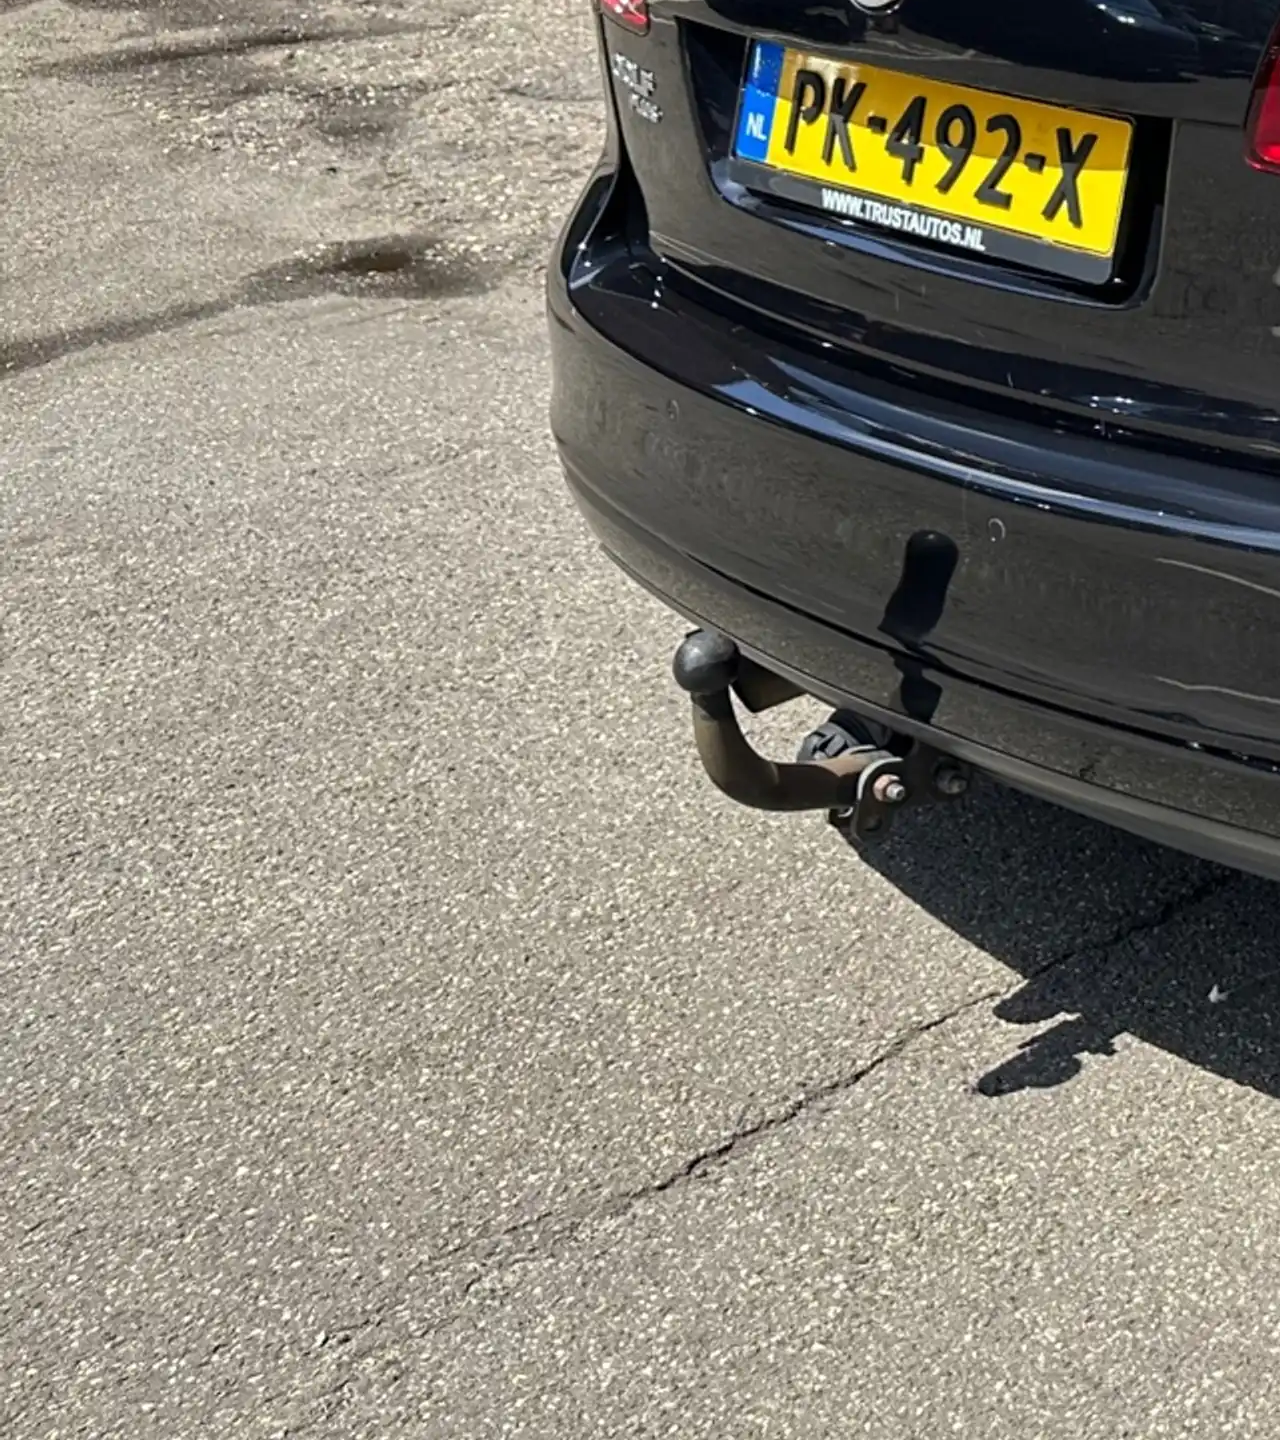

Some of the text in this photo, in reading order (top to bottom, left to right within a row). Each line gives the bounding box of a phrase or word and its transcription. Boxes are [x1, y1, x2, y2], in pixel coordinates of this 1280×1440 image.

[745, 68, 1099, 229] NL PK-492-X
[821, 187, 987, 252] WWW.TRUSTAUTOS.NL
